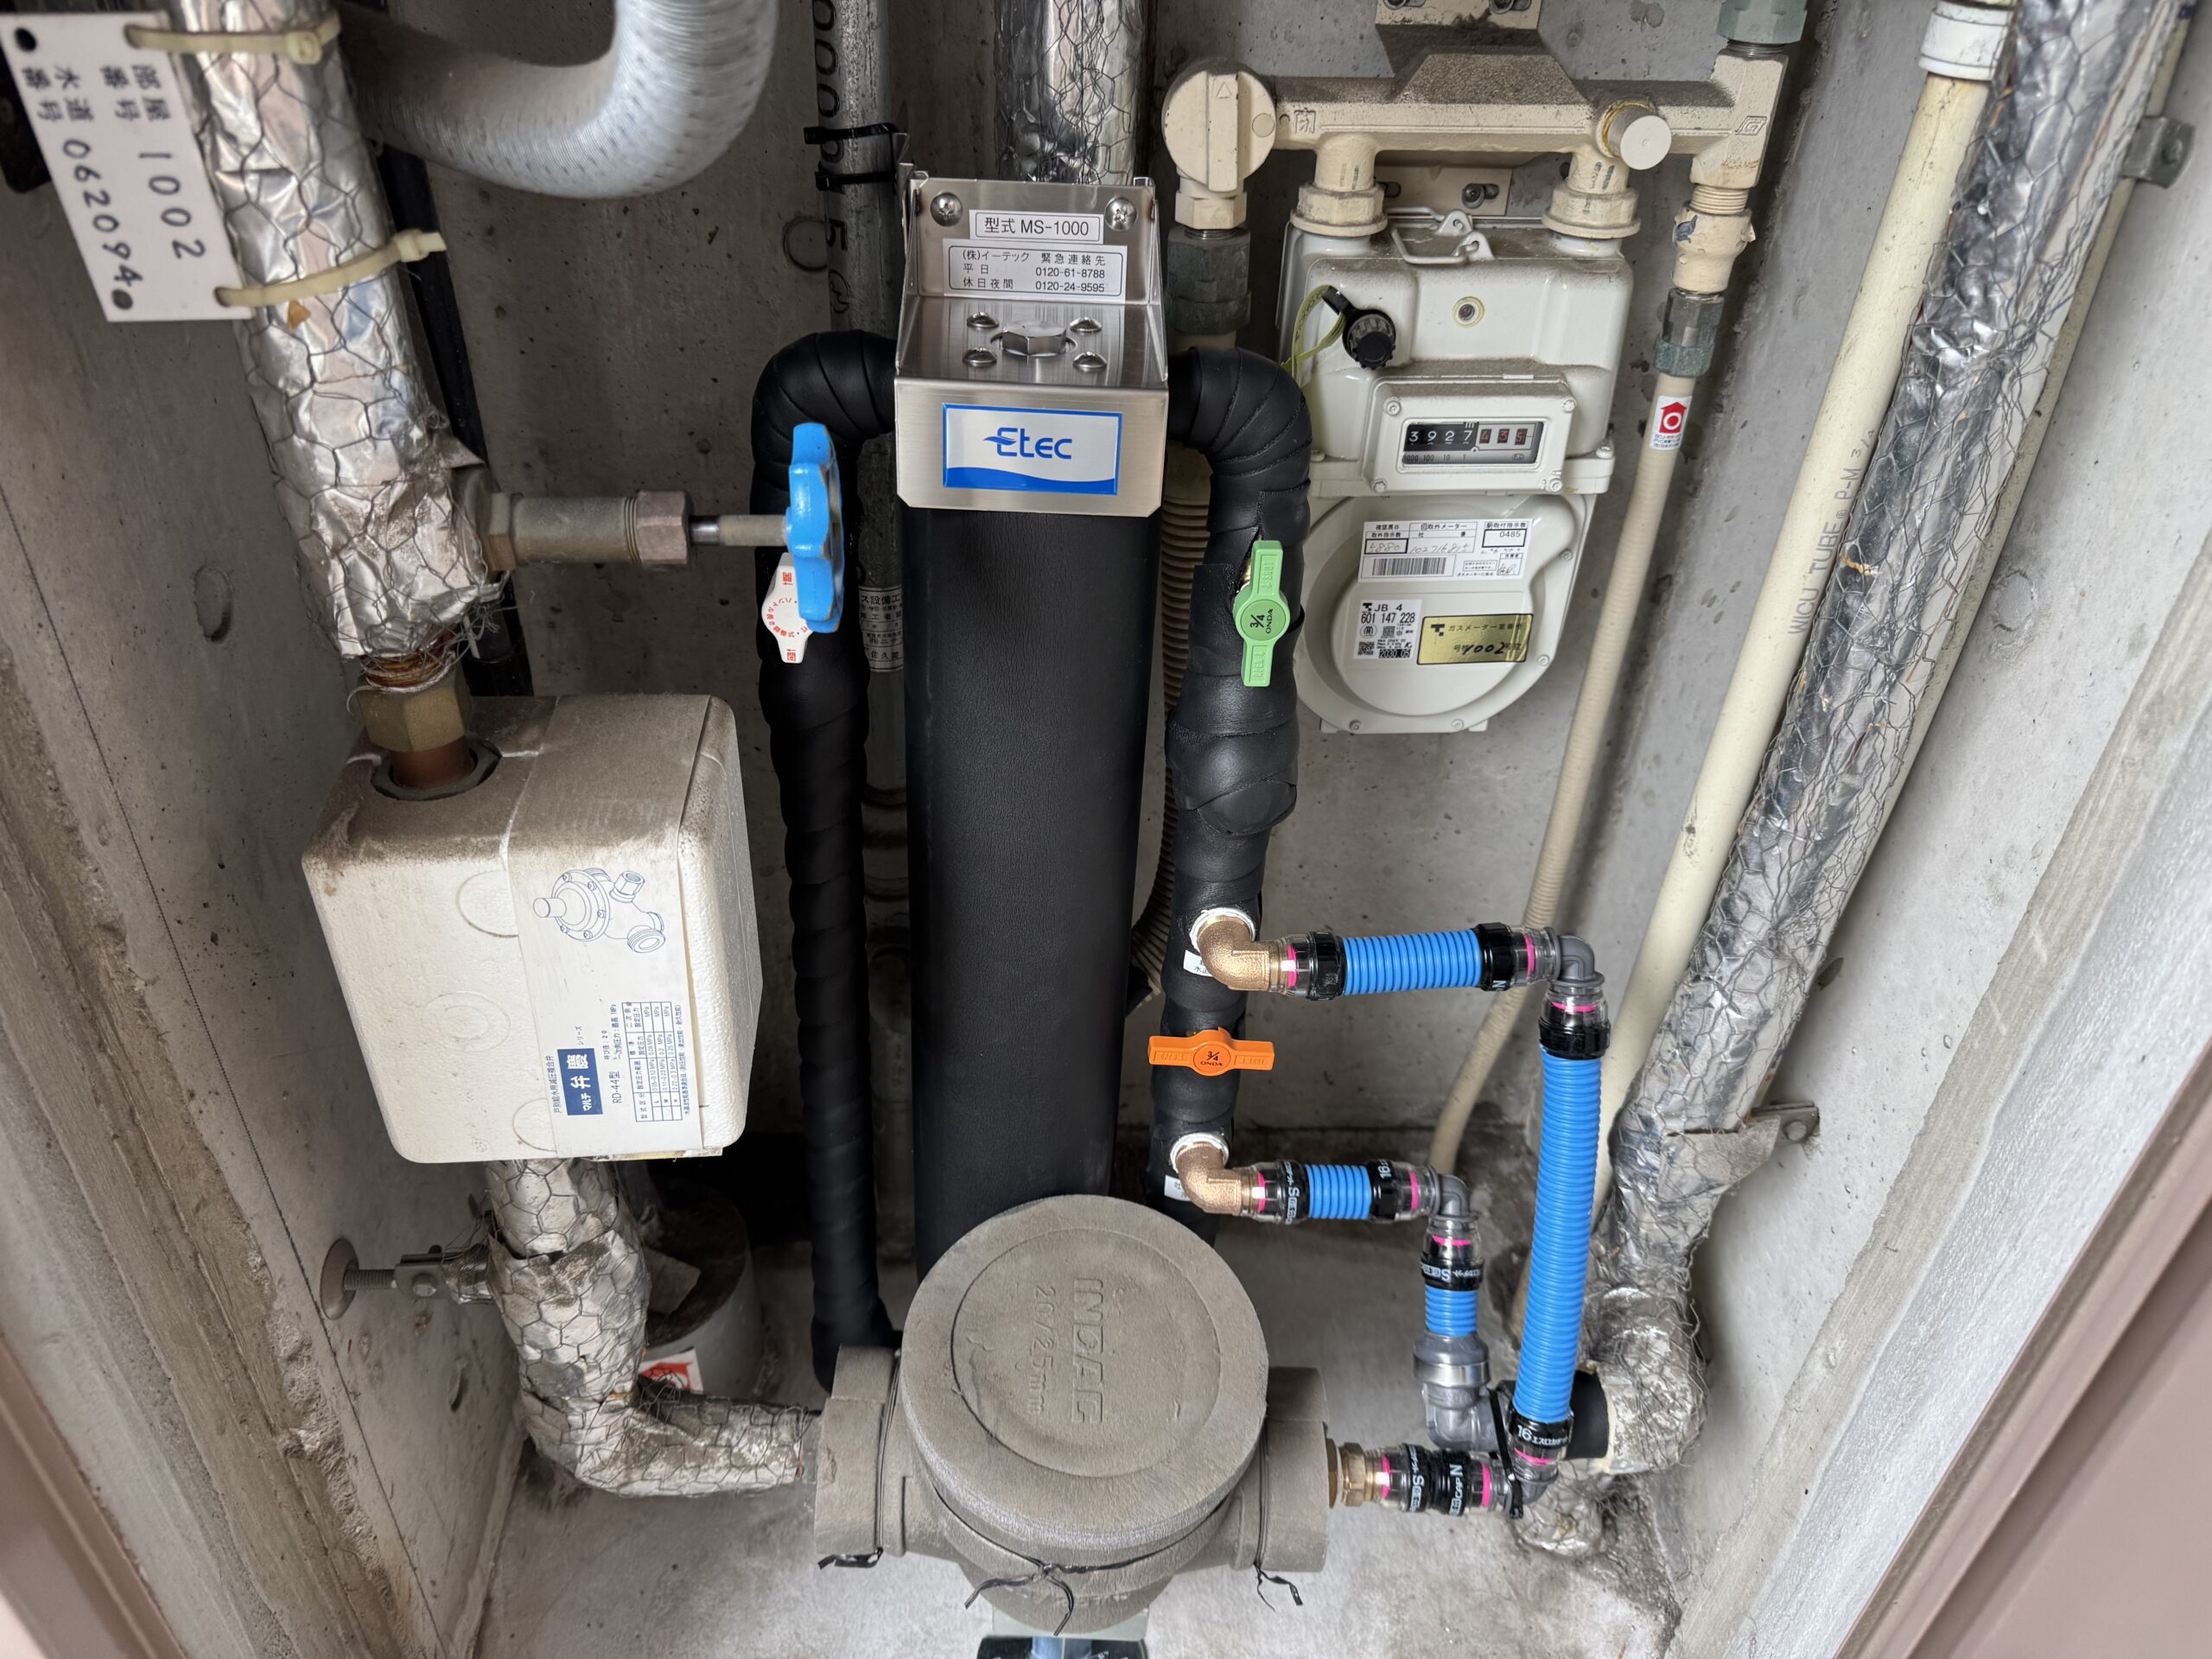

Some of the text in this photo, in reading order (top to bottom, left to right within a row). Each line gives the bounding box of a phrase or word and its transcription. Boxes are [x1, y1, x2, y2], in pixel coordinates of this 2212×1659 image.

[22, 67, 62, 122] 番号
[54, 65, 94, 122] 水道
[62, 138, 143, 287] 062094
[138, 152, 206, 259] 1002
[984, 217, 1090, 236] 型式 MS-1000
[1041, 252, 1106, 267] 緊急連絡先
[963, 263, 1105, 279] 平日 0120-61-8788
[963, 278, 1105, 293] 休日夜間 0120-24-9595
[985, 426, 1073, 461] Etec
[1396, 603, 1403, 612] 4
[1265, 608, 1274, 634] ONDA
[1361, 612, 1415, 624] 601 147 228
[575, 1026, 584, 1046] シリーズ
[608, 1071, 622, 1104] RD-44型
[1377, 1165, 1391, 1179] 16
[1517, 1424, 1532, 1441] 16
